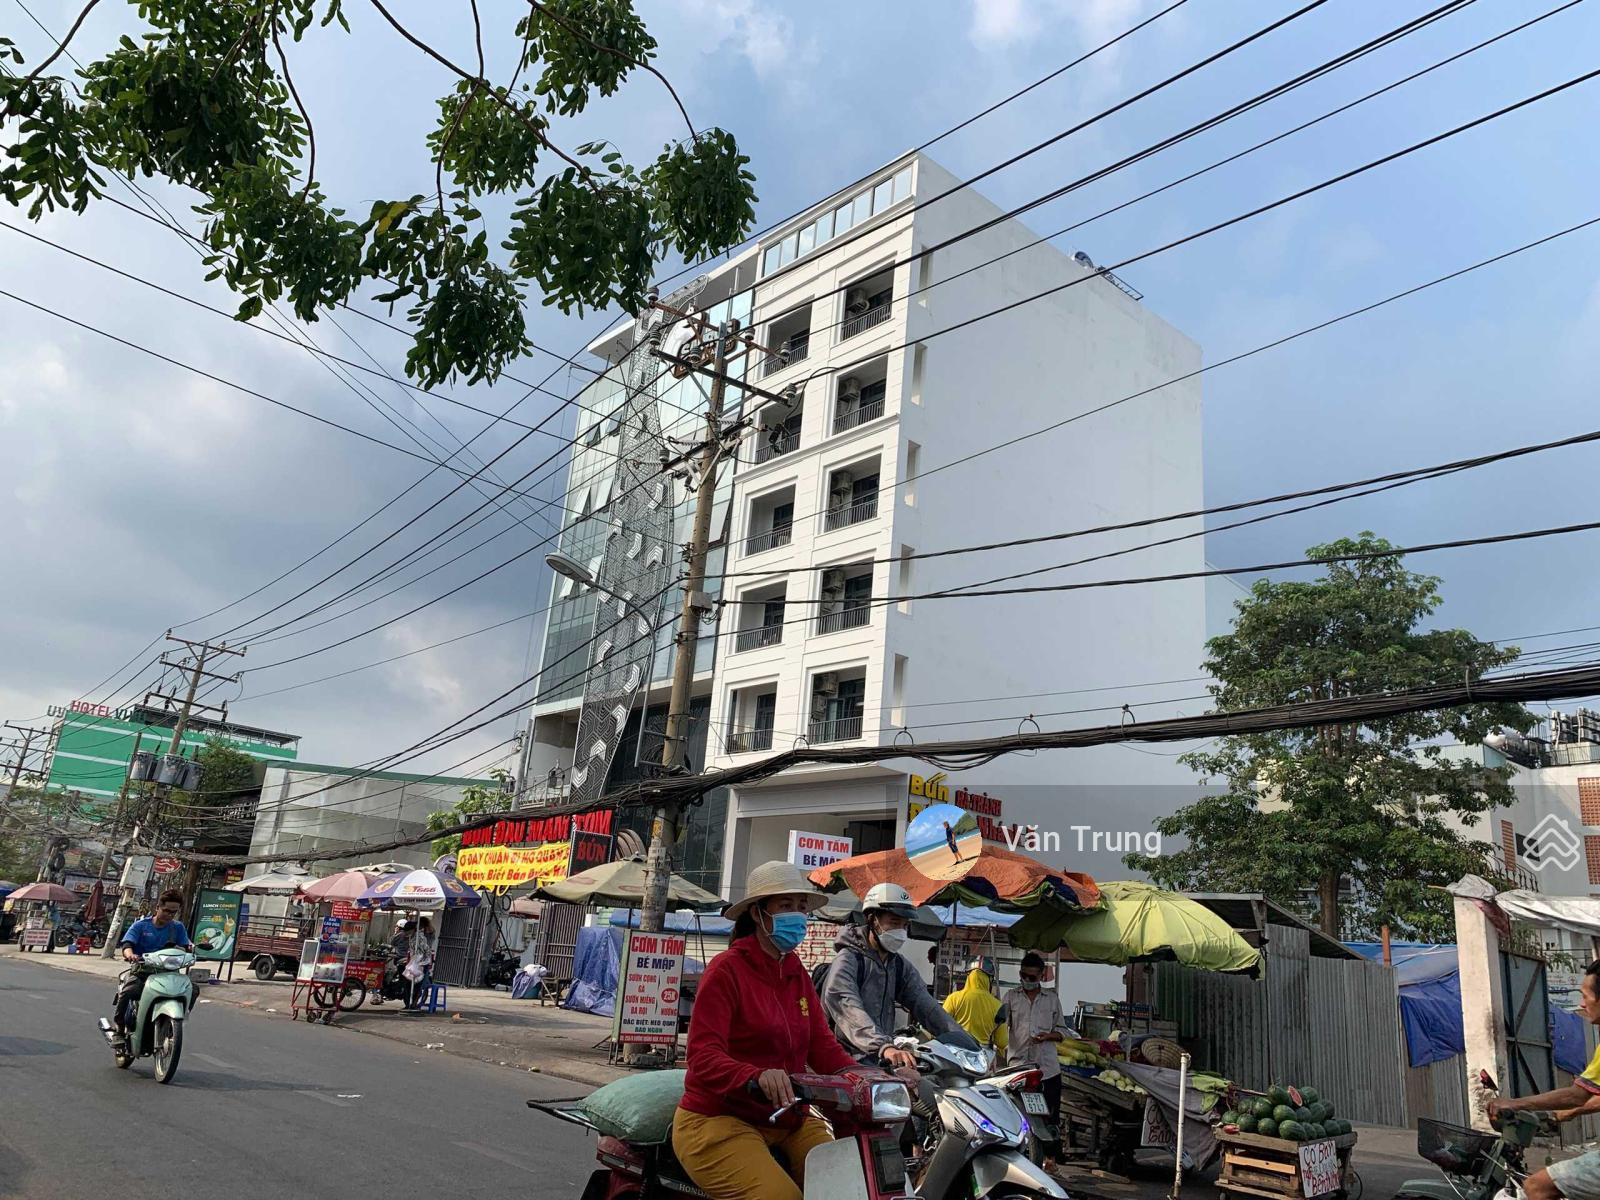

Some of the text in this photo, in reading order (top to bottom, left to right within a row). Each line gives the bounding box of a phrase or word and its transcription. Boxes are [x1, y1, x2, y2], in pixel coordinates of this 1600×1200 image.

[70, 700, 111, 718] HOTEL
[909, 772, 949, 801] Bún
[803, 853, 817, 866] BÉ
[632, 935, 684, 955] CƠM TẤM
[637, 956, 675, 972] BÉ MẬP
